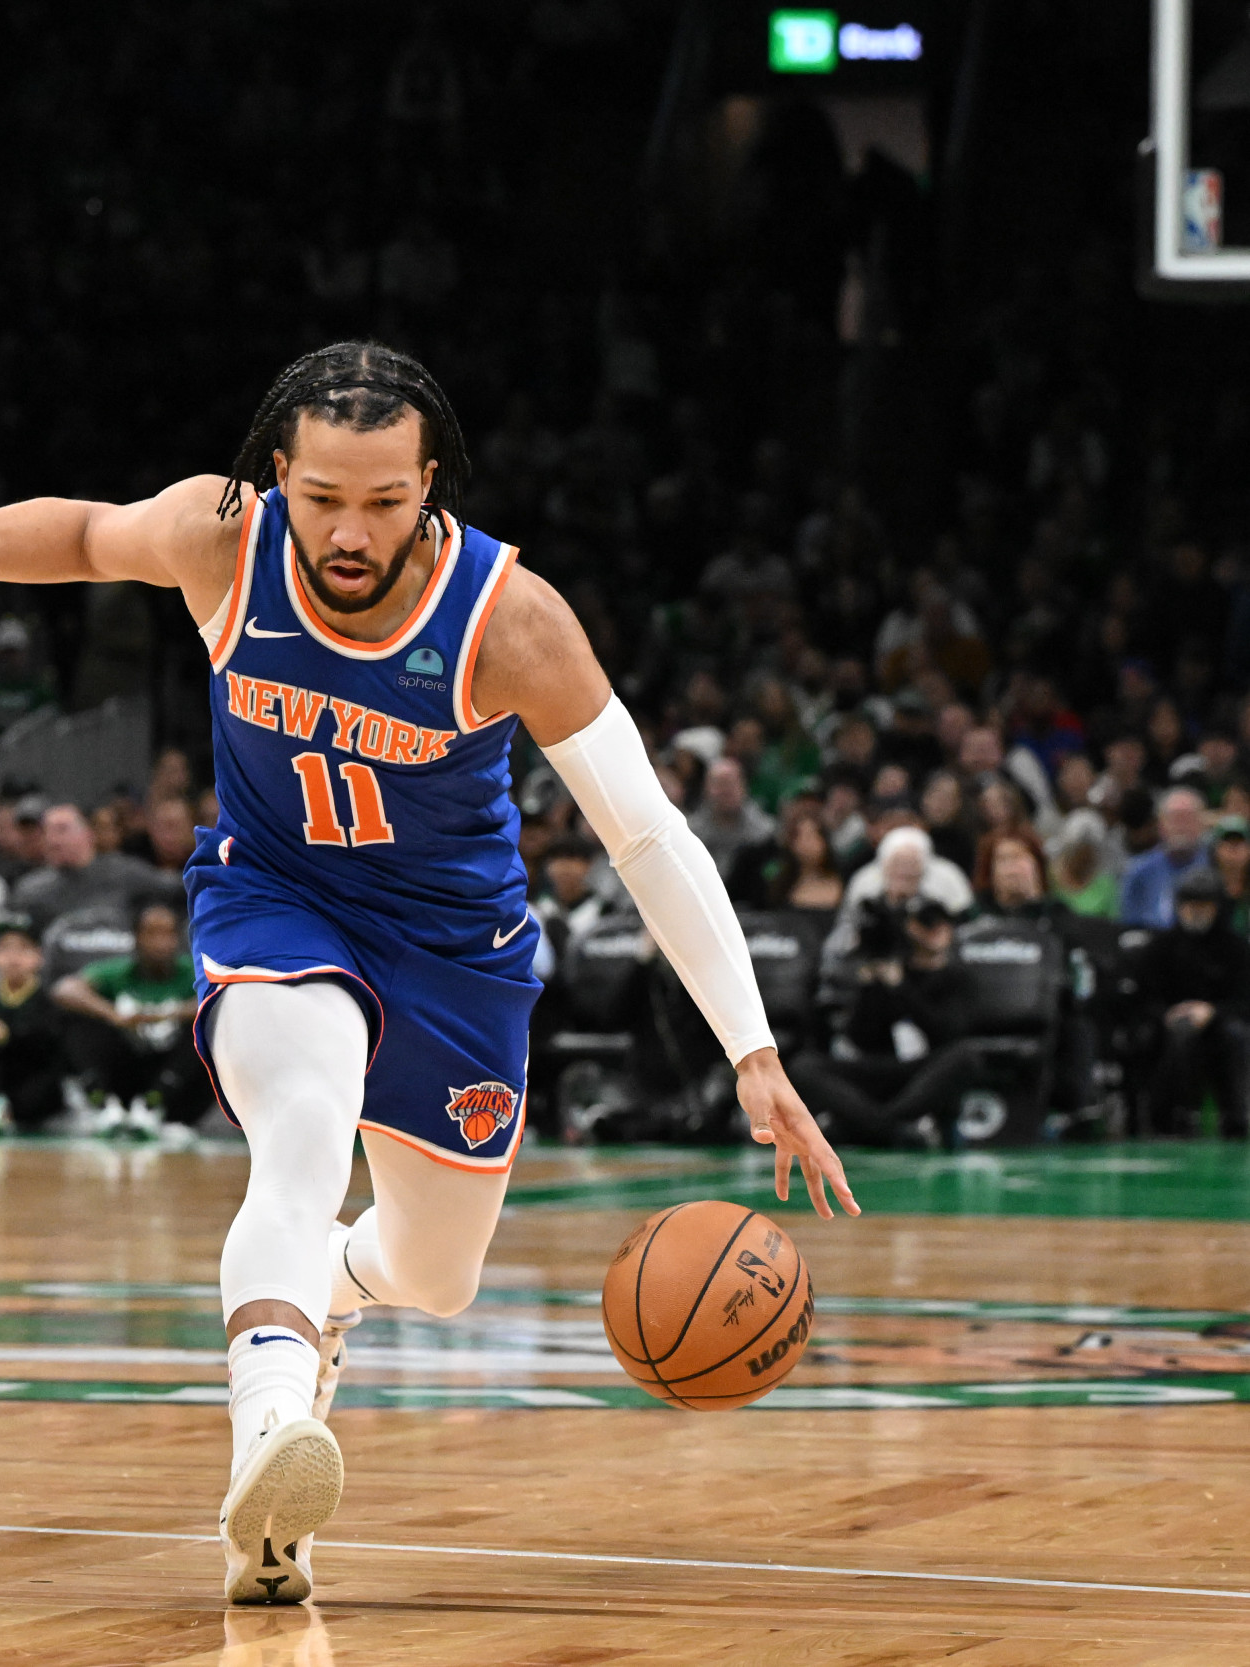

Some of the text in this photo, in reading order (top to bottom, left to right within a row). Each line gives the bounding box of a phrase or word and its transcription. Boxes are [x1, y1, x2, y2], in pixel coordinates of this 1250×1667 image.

[397, 676, 447, 692] sphere
[226, 669, 458, 765] NEW YORK
[291, 752, 395, 848] 11
[450, 1089, 512, 1117] KNICKS
